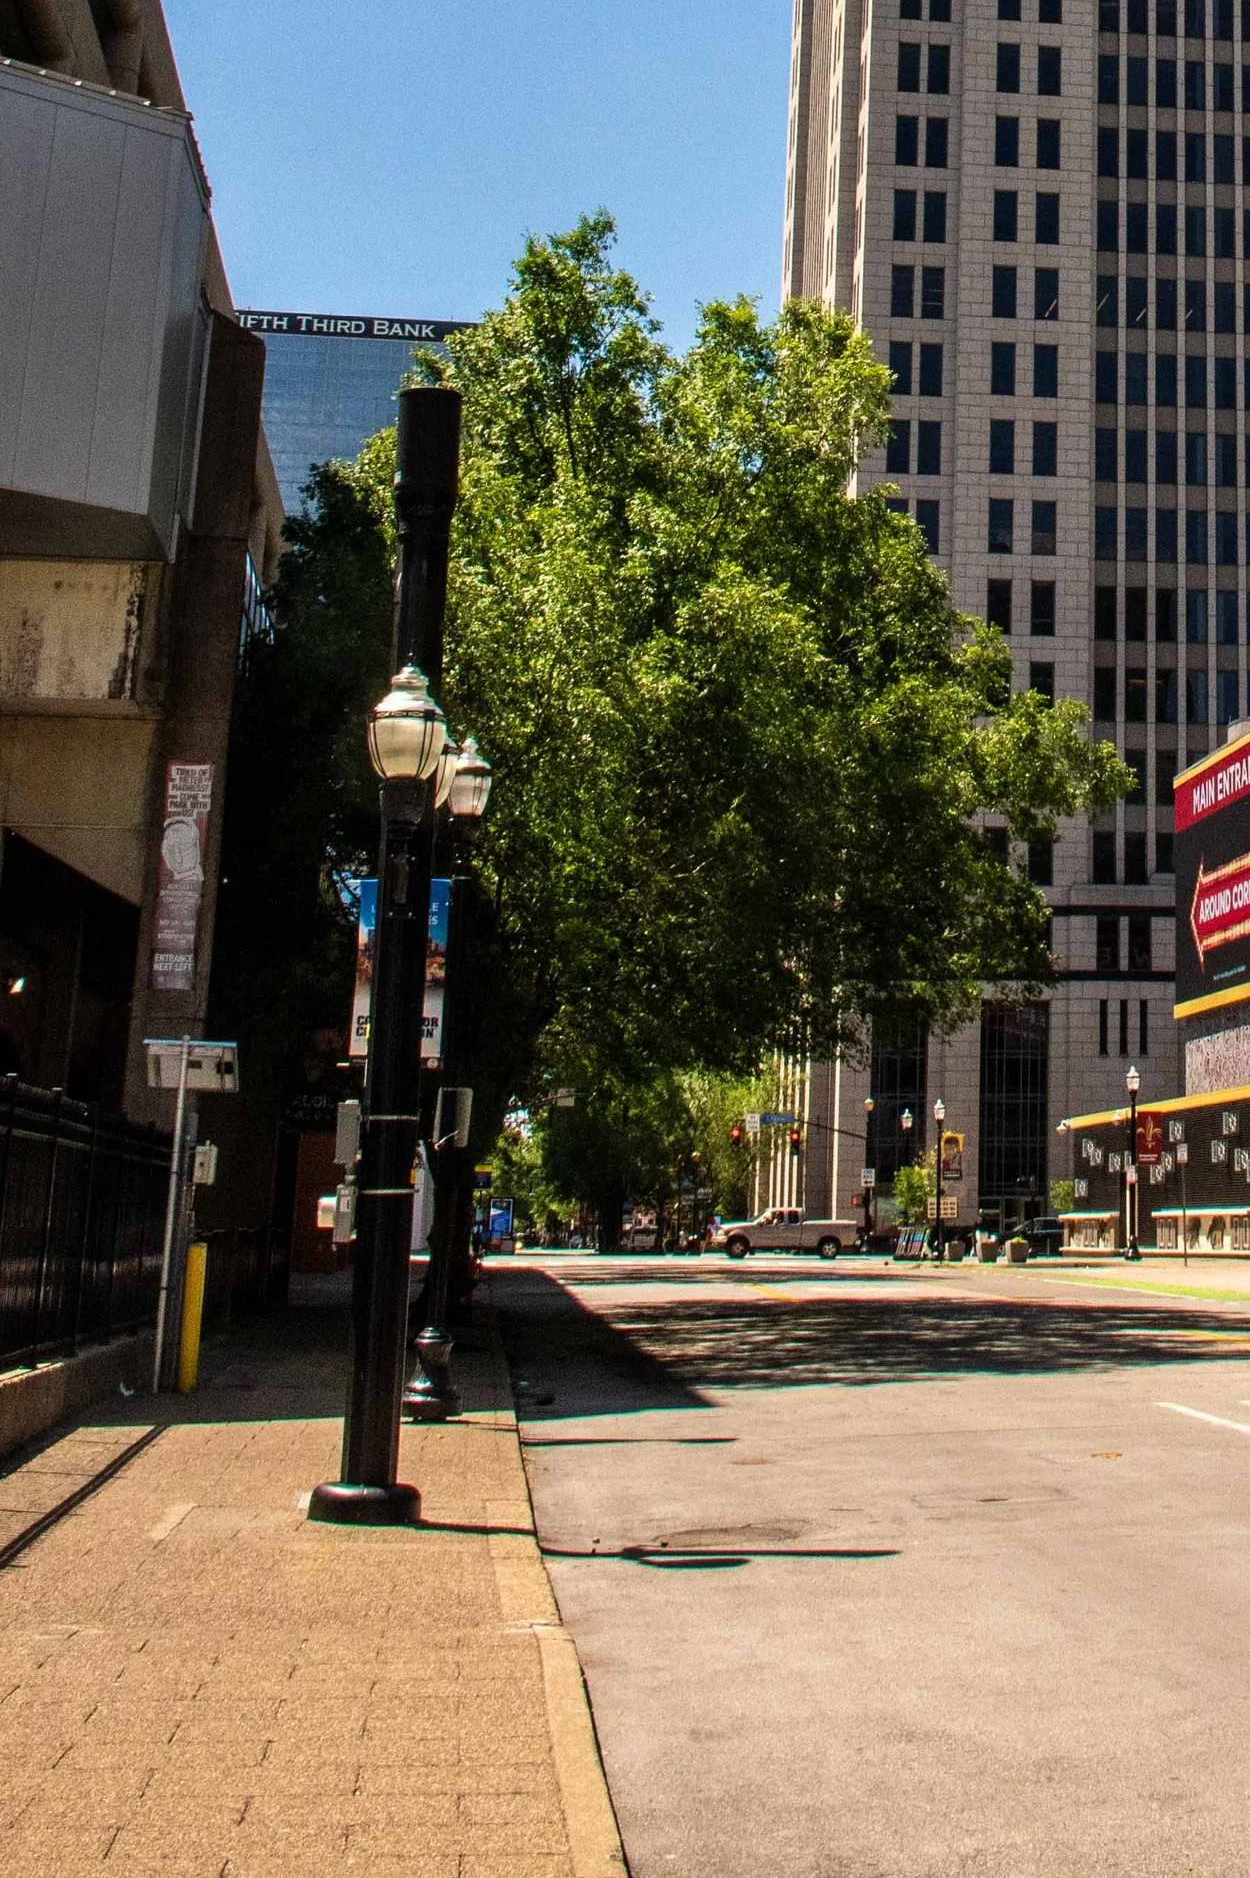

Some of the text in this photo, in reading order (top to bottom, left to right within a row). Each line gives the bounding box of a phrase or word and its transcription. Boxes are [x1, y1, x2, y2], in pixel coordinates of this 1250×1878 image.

[236, 312, 435, 338] IFTH THIRD BANK
[1193, 778, 1215, 815] MAIN
[1200, 889, 1231, 924] AROUND
[153, 962, 193, 971] NEXT LEFT
[155, 953, 194, 963] ENTRANCE
